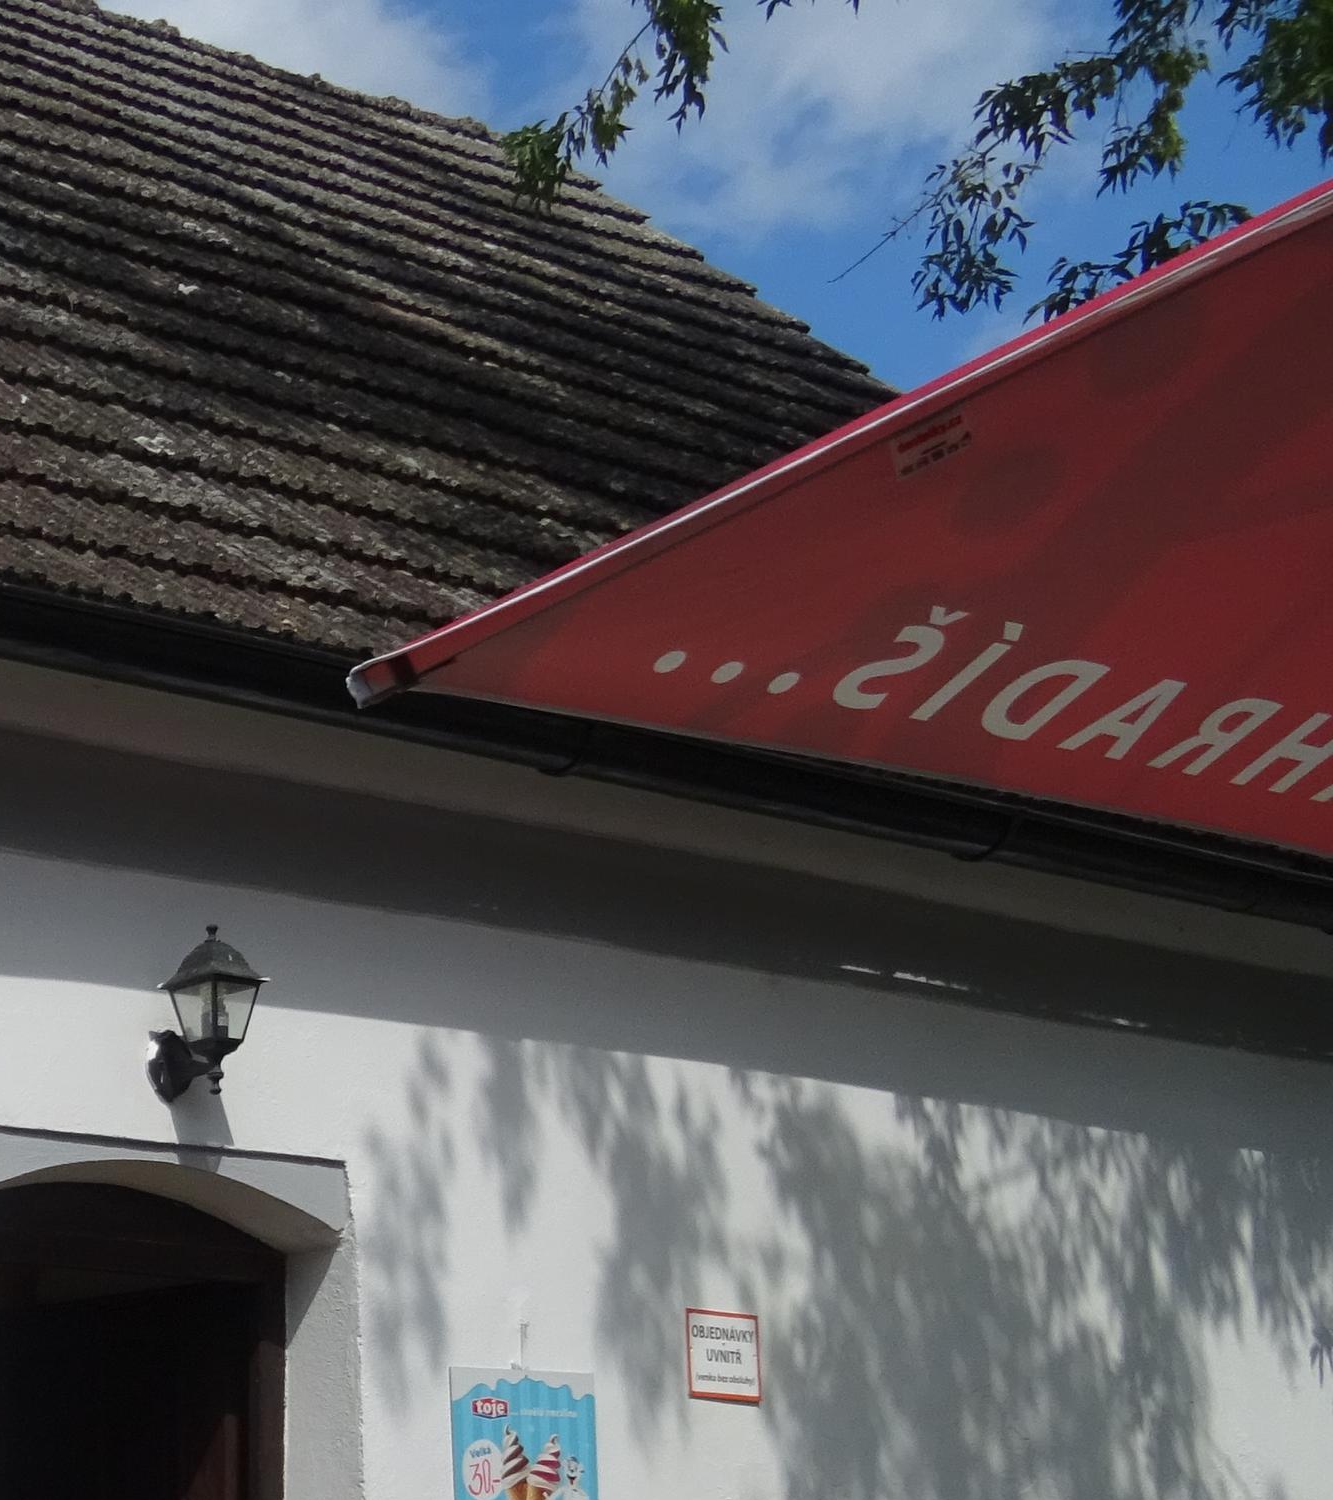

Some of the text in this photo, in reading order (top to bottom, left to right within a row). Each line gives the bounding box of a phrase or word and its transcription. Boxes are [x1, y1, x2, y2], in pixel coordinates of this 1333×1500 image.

[691, 1324, 754, 1344] OBJEDNÁVKY
[706, 1348, 742, 1365] UVNITŘ
[475, 1399, 506, 1417] toje
